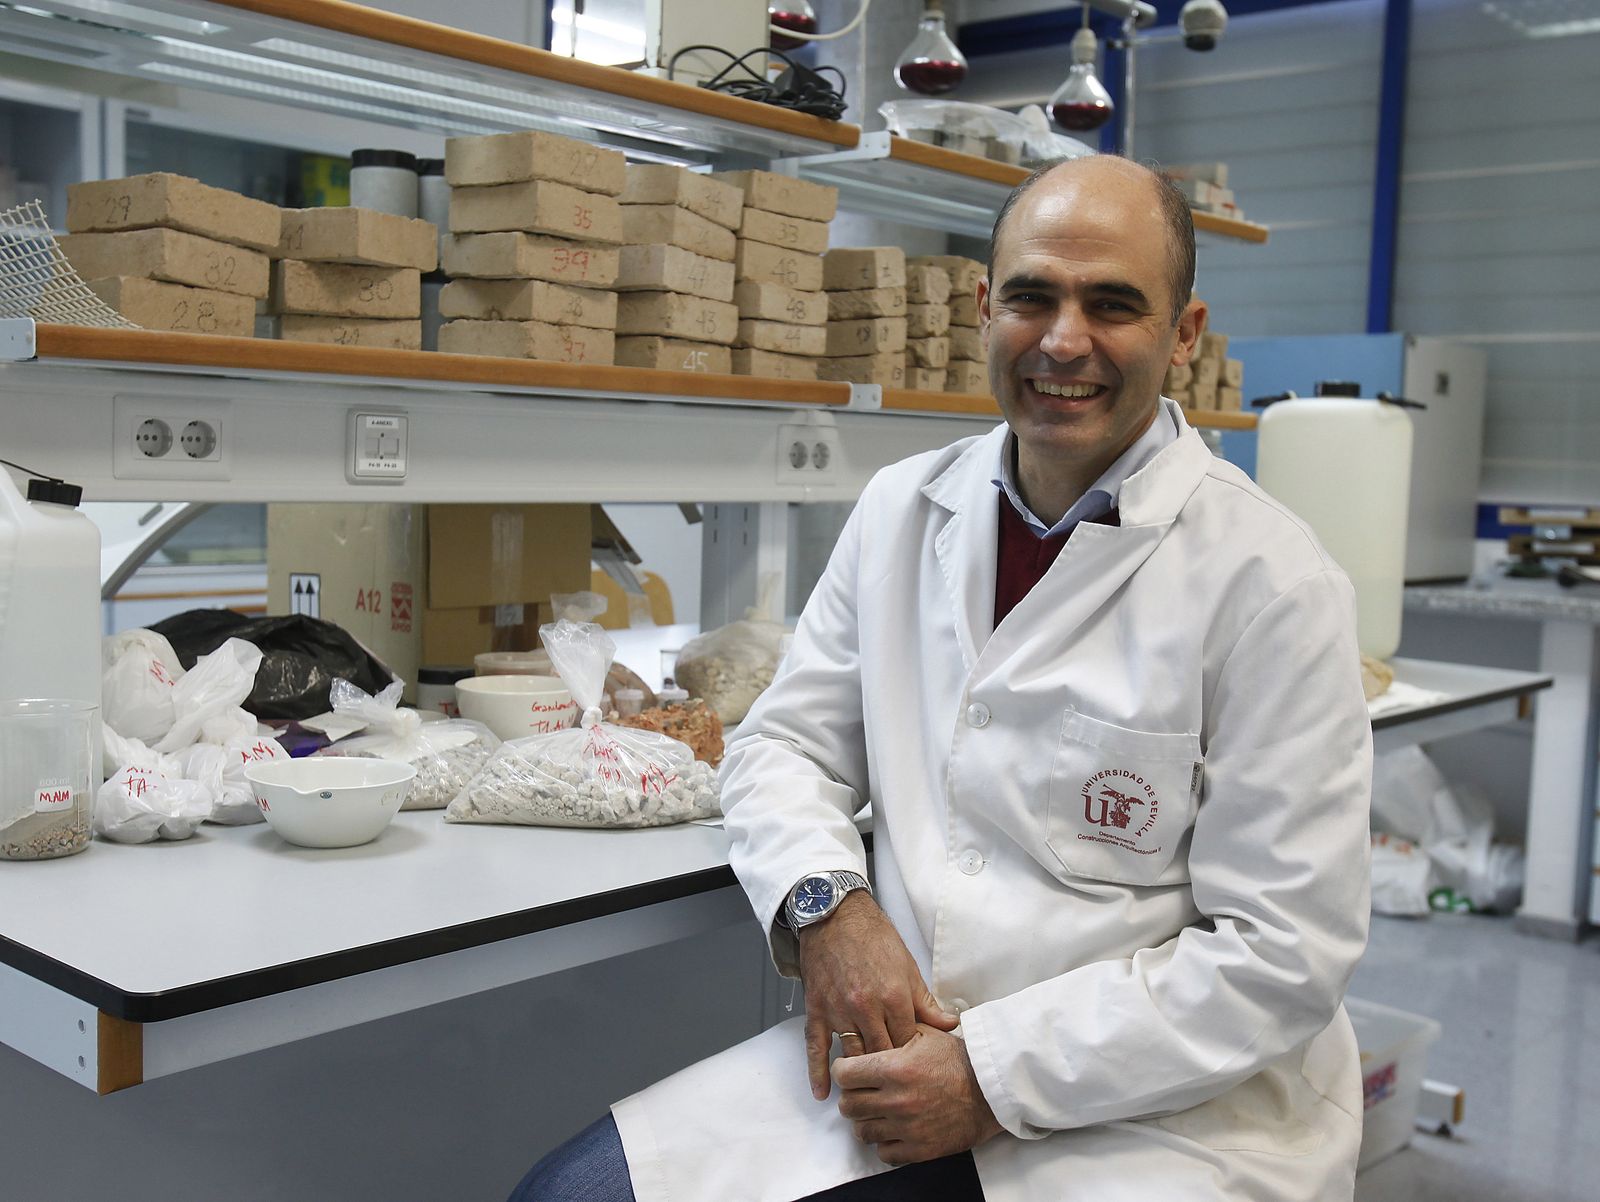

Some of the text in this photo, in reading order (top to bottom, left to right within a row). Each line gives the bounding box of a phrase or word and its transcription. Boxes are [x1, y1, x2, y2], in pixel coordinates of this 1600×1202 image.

[104, 194, 131, 224] 29
[573, 205, 593, 230] 35
[203, 251, 237, 287] 32
[552, 247, 590, 278] 39
[358, 277, 393, 303] 30
[170, 300, 219, 332] 28
[682, 351, 709, 372] 45
[355, 588, 382, 614] A12
[1081, 768, 1158, 838] UNIVERSIDAD DE SEVILLA
[1077, 833, 1119, 847] Construcciones
[1098, 830, 1136, 846] Departamento
